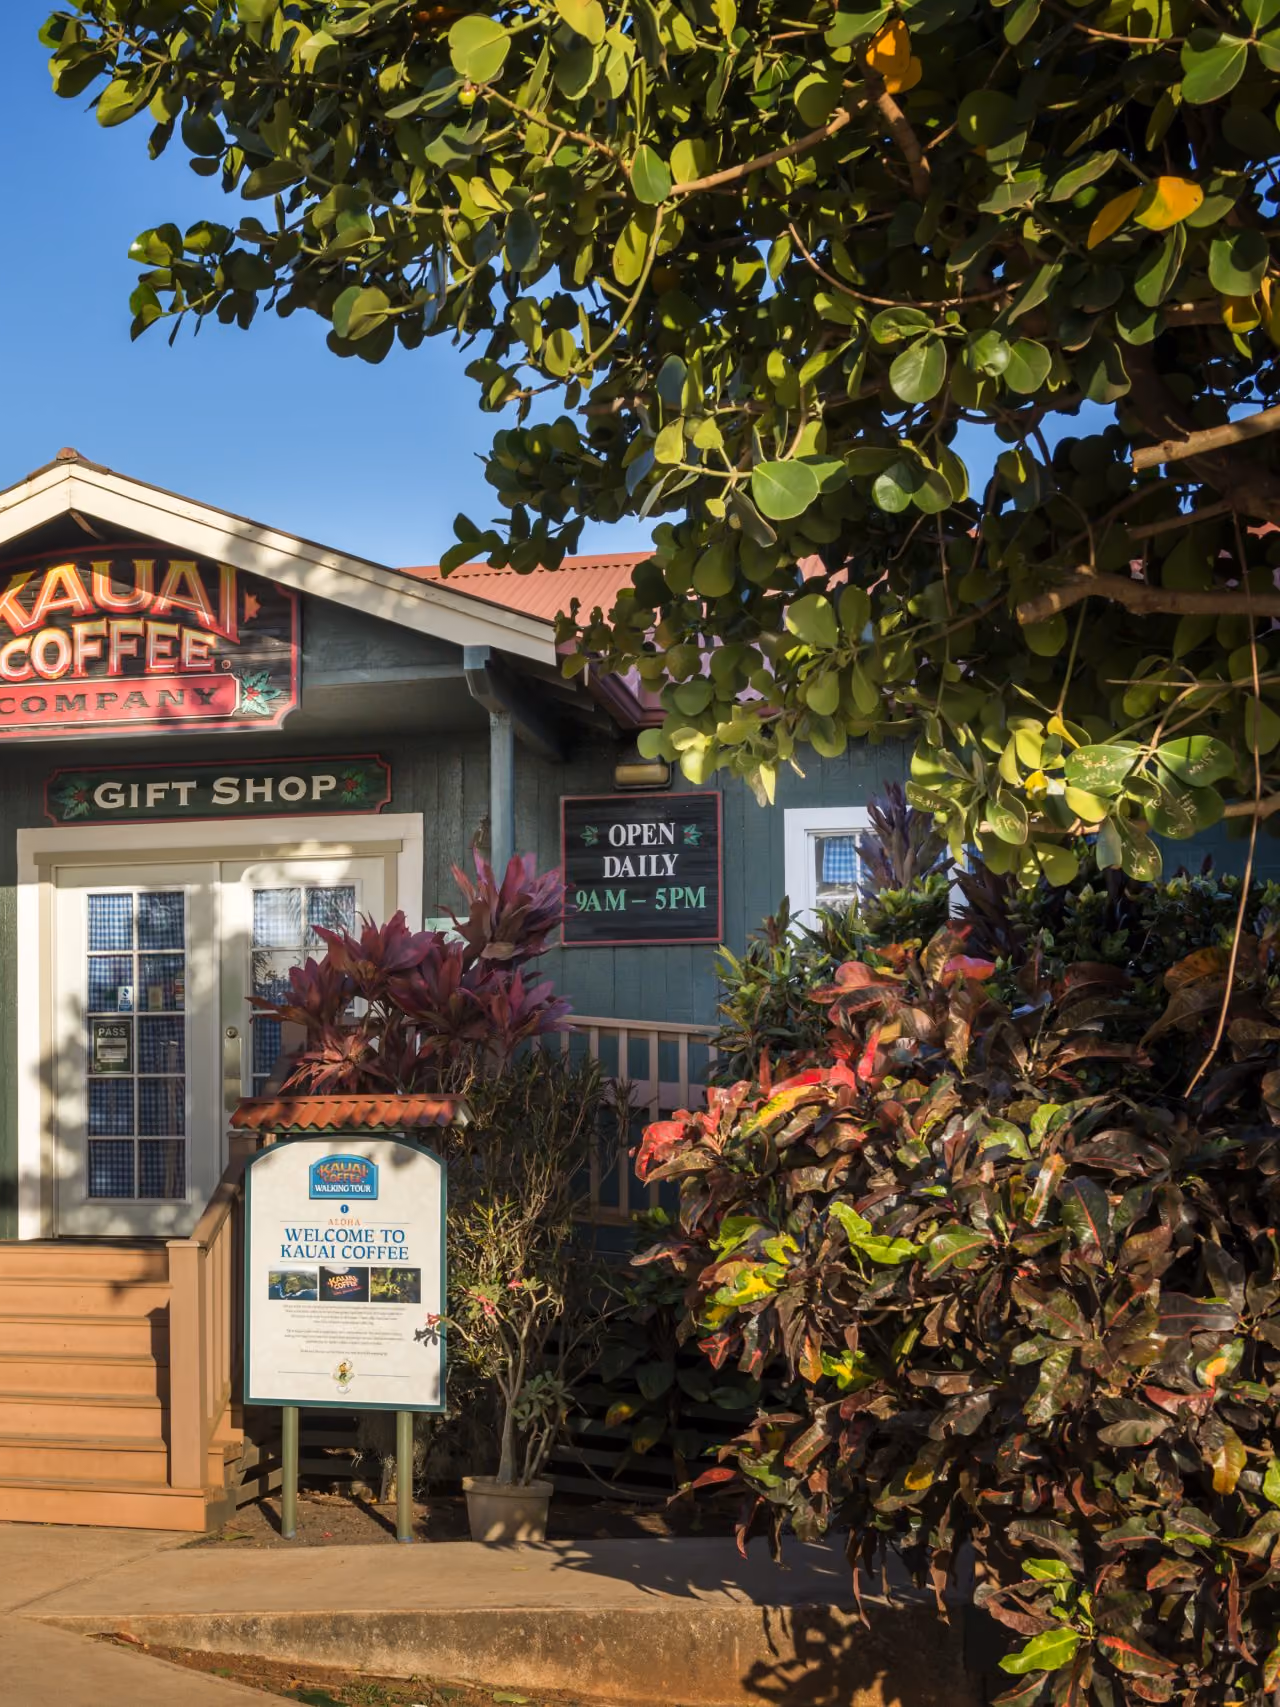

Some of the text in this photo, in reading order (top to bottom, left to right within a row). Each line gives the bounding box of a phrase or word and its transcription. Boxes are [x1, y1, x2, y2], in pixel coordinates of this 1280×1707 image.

[93, 774, 337, 810] GIFT SHOP
[608, 822, 676, 847] OPEN
[602, 853, 680, 878] DAILY
[575, 888, 627, 912] 9AM
[654, 886, 707, 911] 5PM
[97, 1027, 126, 1037] PASS
[314, 1184, 372, 1193] WALKING TOUR
[327, 1218, 361, 1226] ALOHA
[284, 1228, 405, 1244] WELCOME TO
[280, 1244, 410, 1261] KAUAI COFFEE
